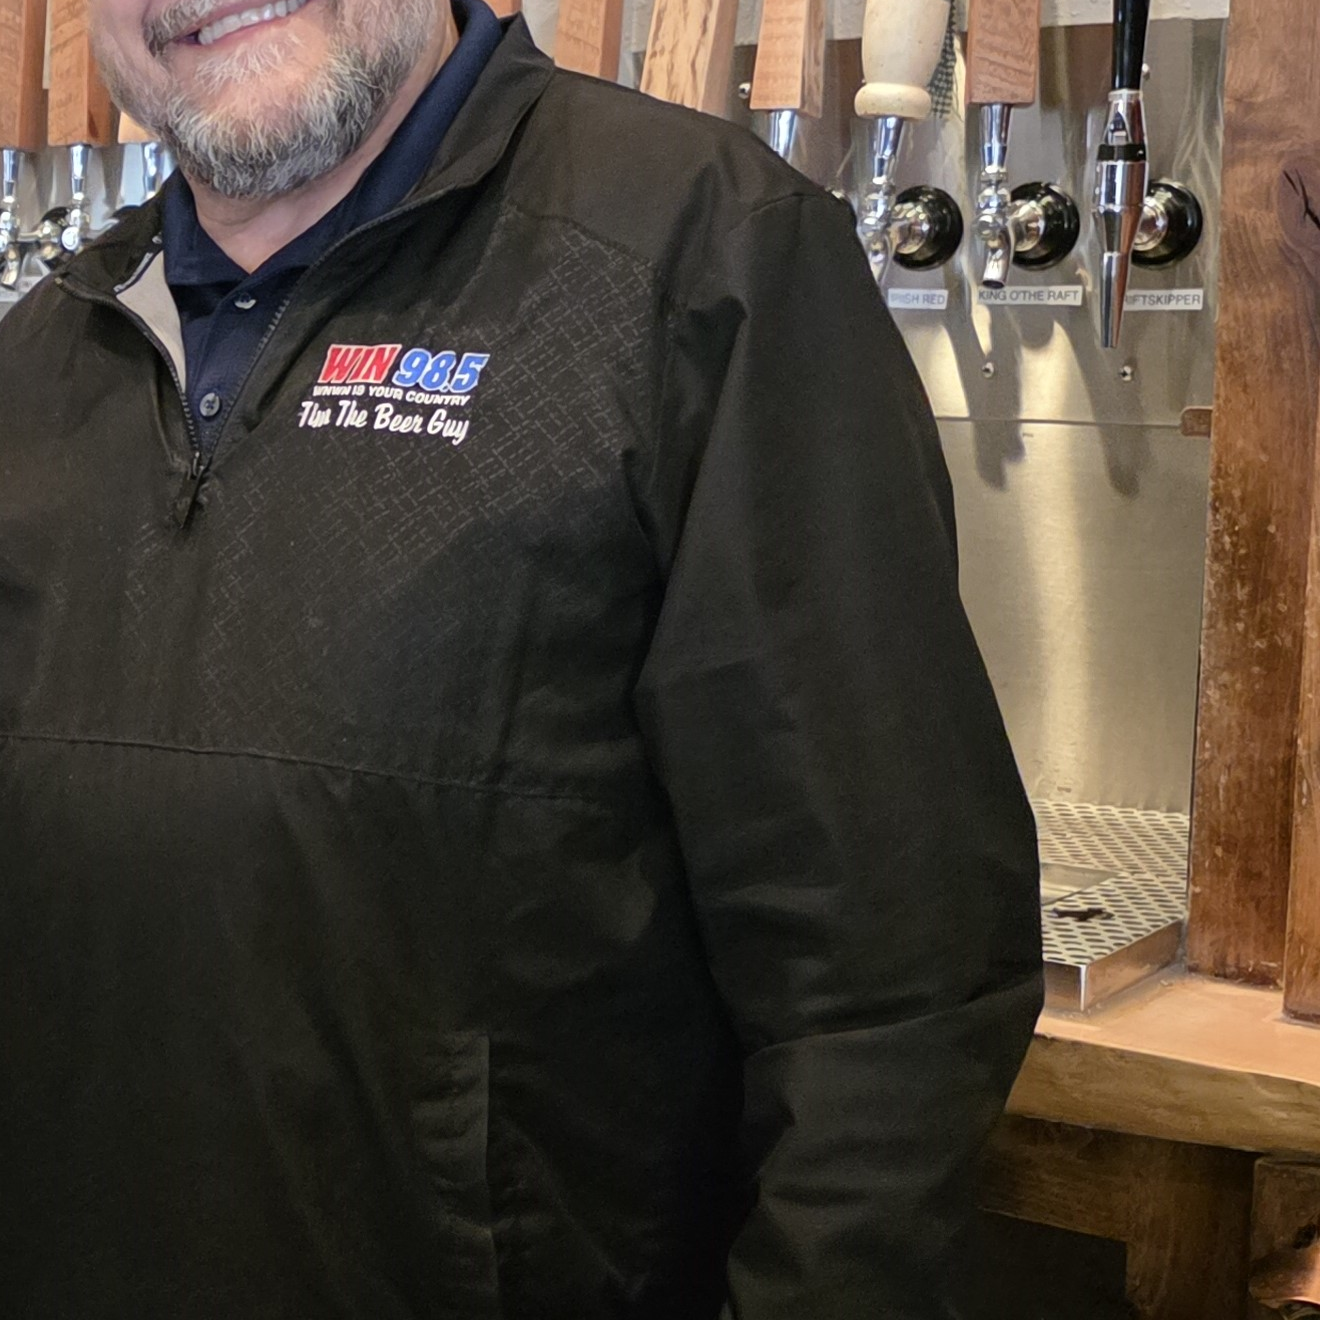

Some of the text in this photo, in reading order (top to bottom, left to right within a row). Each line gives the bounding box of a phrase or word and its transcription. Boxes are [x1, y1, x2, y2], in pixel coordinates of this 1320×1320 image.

[922, 293, 946, 305] RED
[978, 289, 1007, 301] KING
[1047, 289, 1080, 302] RAFT
[317, 343, 403, 385] WIN
[368, 385, 403, 401] YOUR
[405, 390, 471, 407] COUNTRY
[335, 399, 368, 428] The
[373, 402, 425, 434] Beer
[426, 408, 470, 446] Guy
